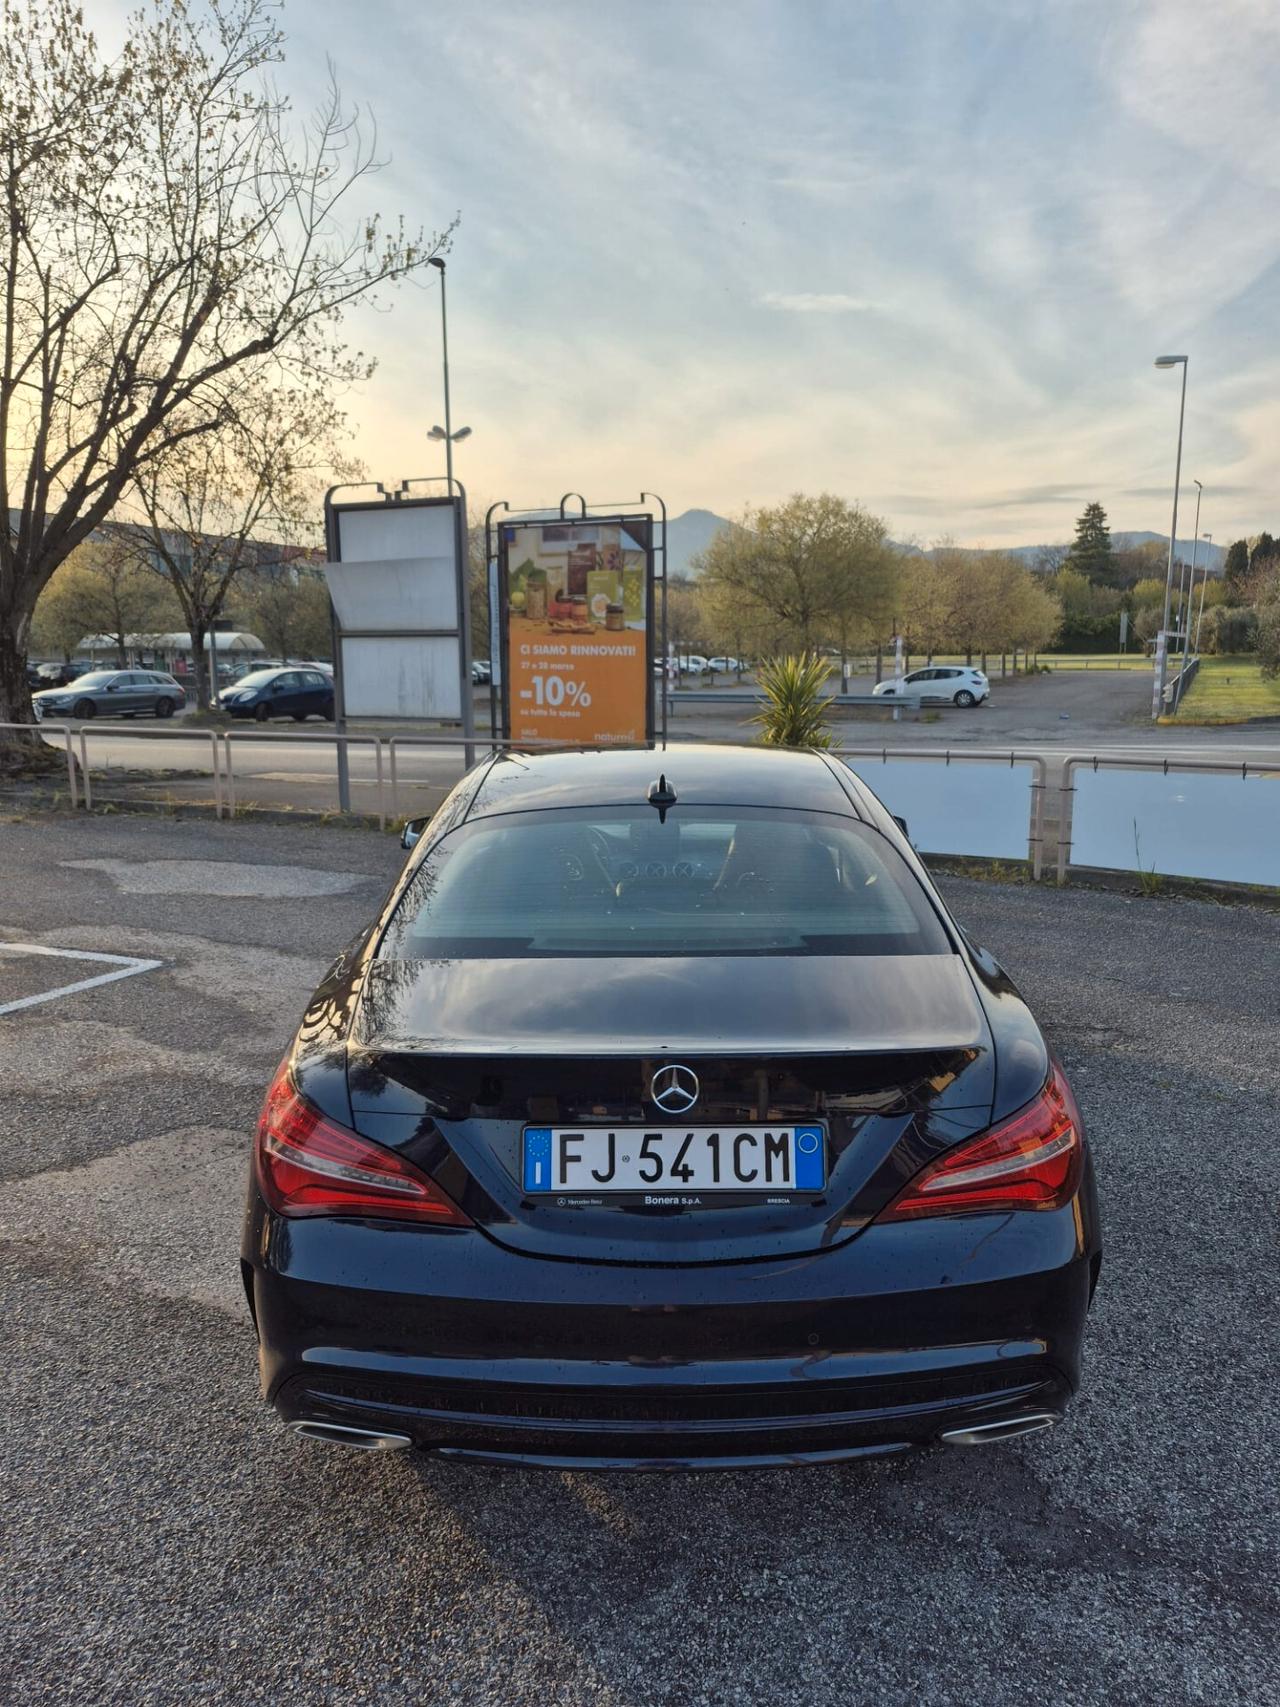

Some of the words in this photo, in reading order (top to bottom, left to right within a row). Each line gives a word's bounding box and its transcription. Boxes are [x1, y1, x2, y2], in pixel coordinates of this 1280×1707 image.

[520, 644, 530, 655] CI
[533, 645, 567, 655] SIAMO
[571, 645, 636, 656] RINNOVATI!
[520, 675, 592, 707] -10%
[644, 1196, 679, 1205] Bonera
